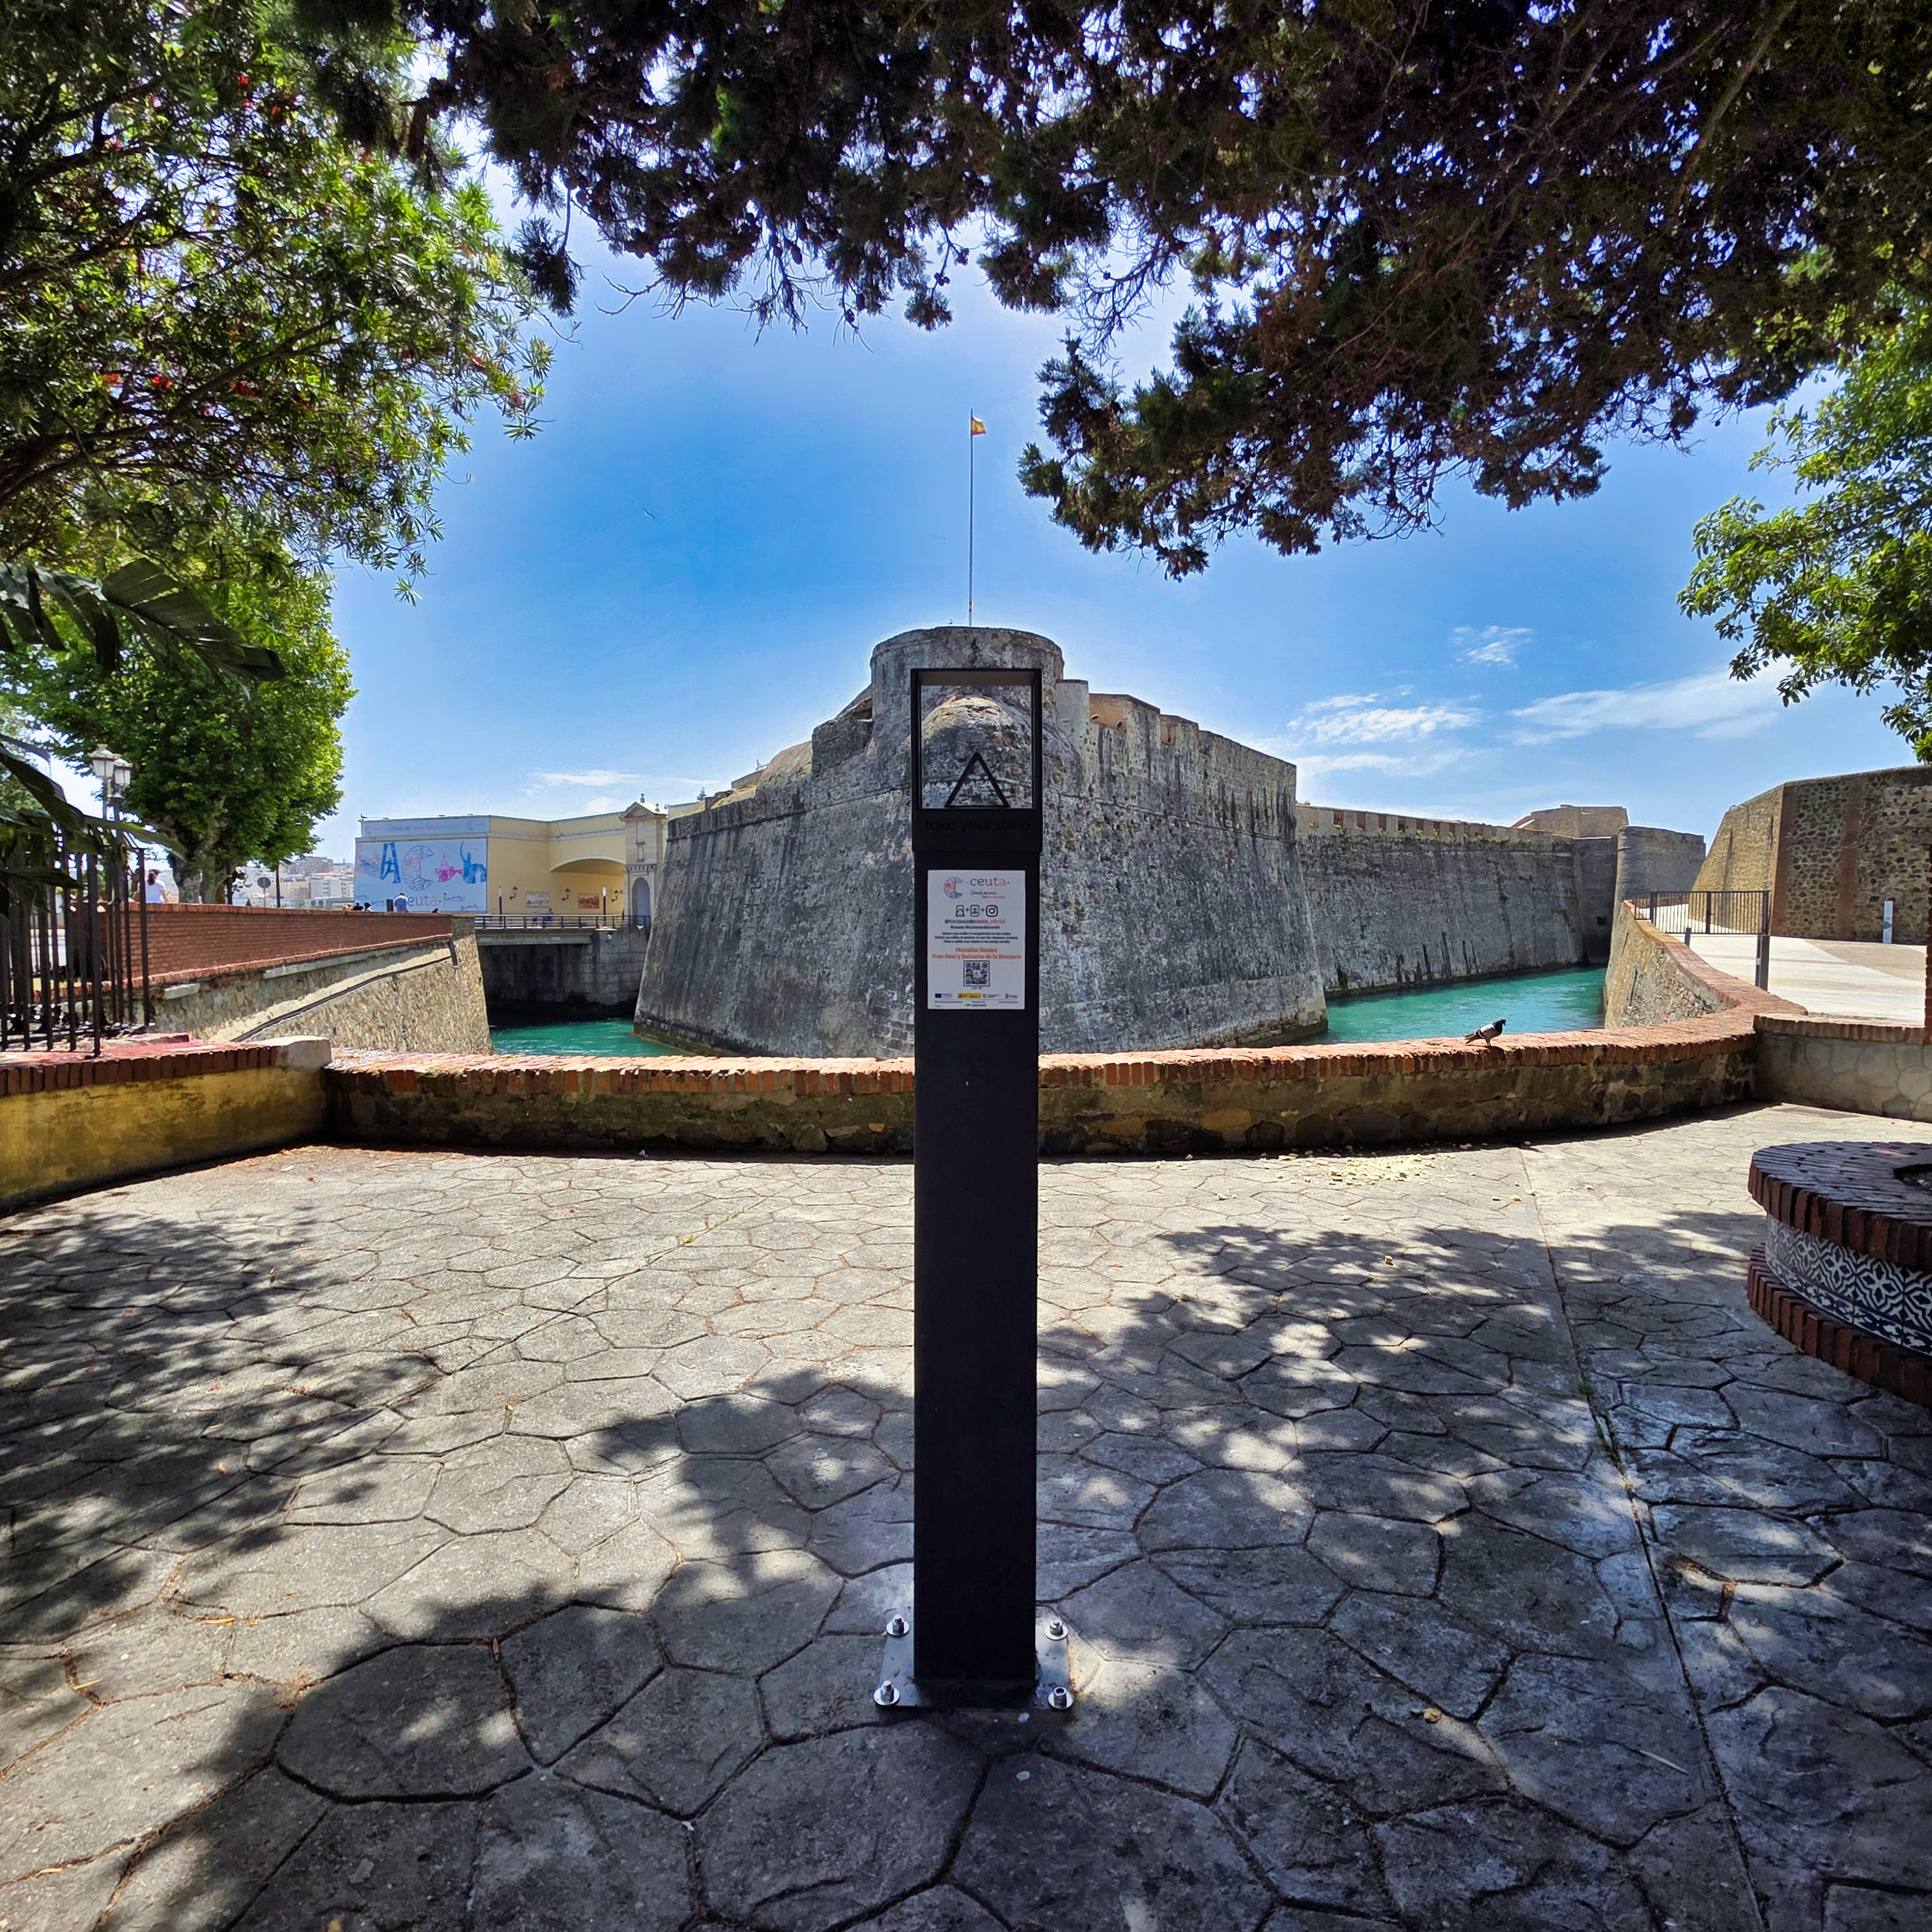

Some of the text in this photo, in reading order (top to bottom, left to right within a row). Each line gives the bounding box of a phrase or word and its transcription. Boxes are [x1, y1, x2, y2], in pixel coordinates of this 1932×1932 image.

[925, 818, 1031, 833] take your selfie
